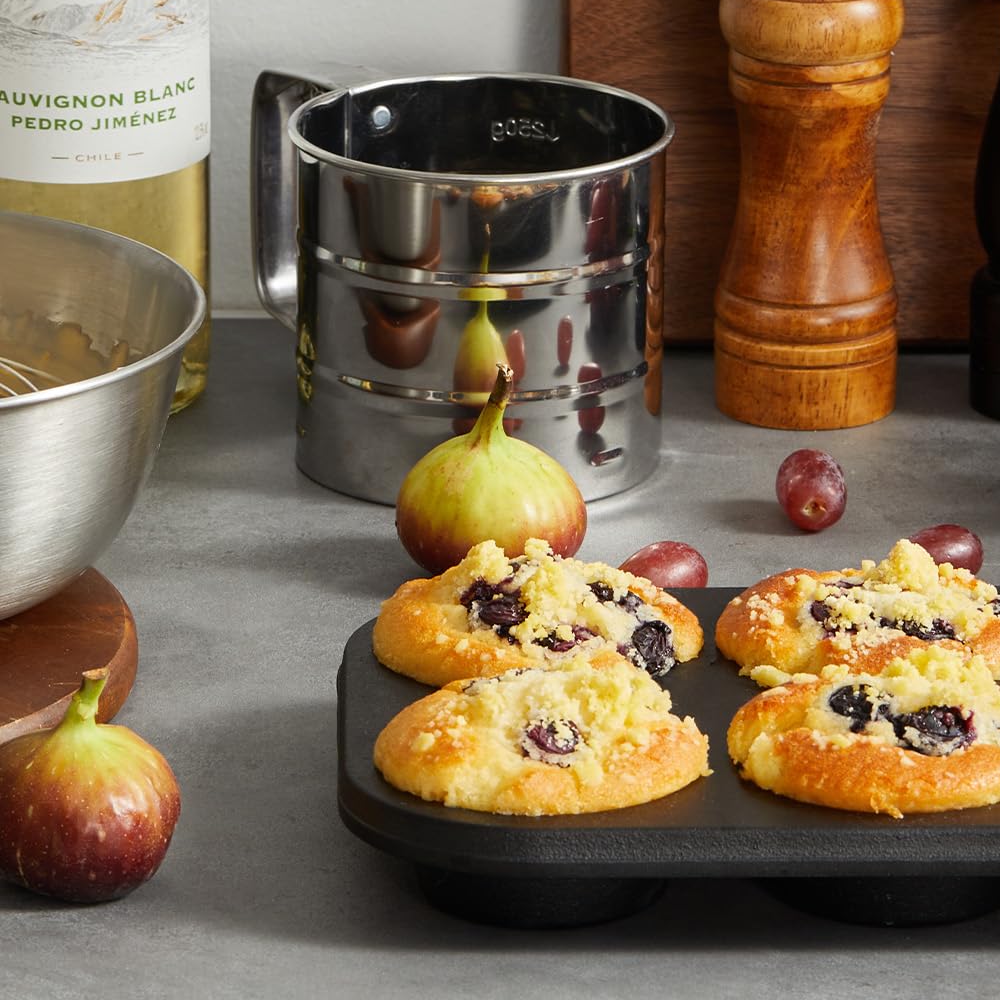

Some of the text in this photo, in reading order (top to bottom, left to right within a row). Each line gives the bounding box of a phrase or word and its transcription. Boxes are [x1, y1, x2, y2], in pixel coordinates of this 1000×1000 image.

[134, 77, 196, 104] BLANC
[11, 108, 177, 131] PEDRO JIMÉNEZ
[75, 152, 122, 162] CHILE
